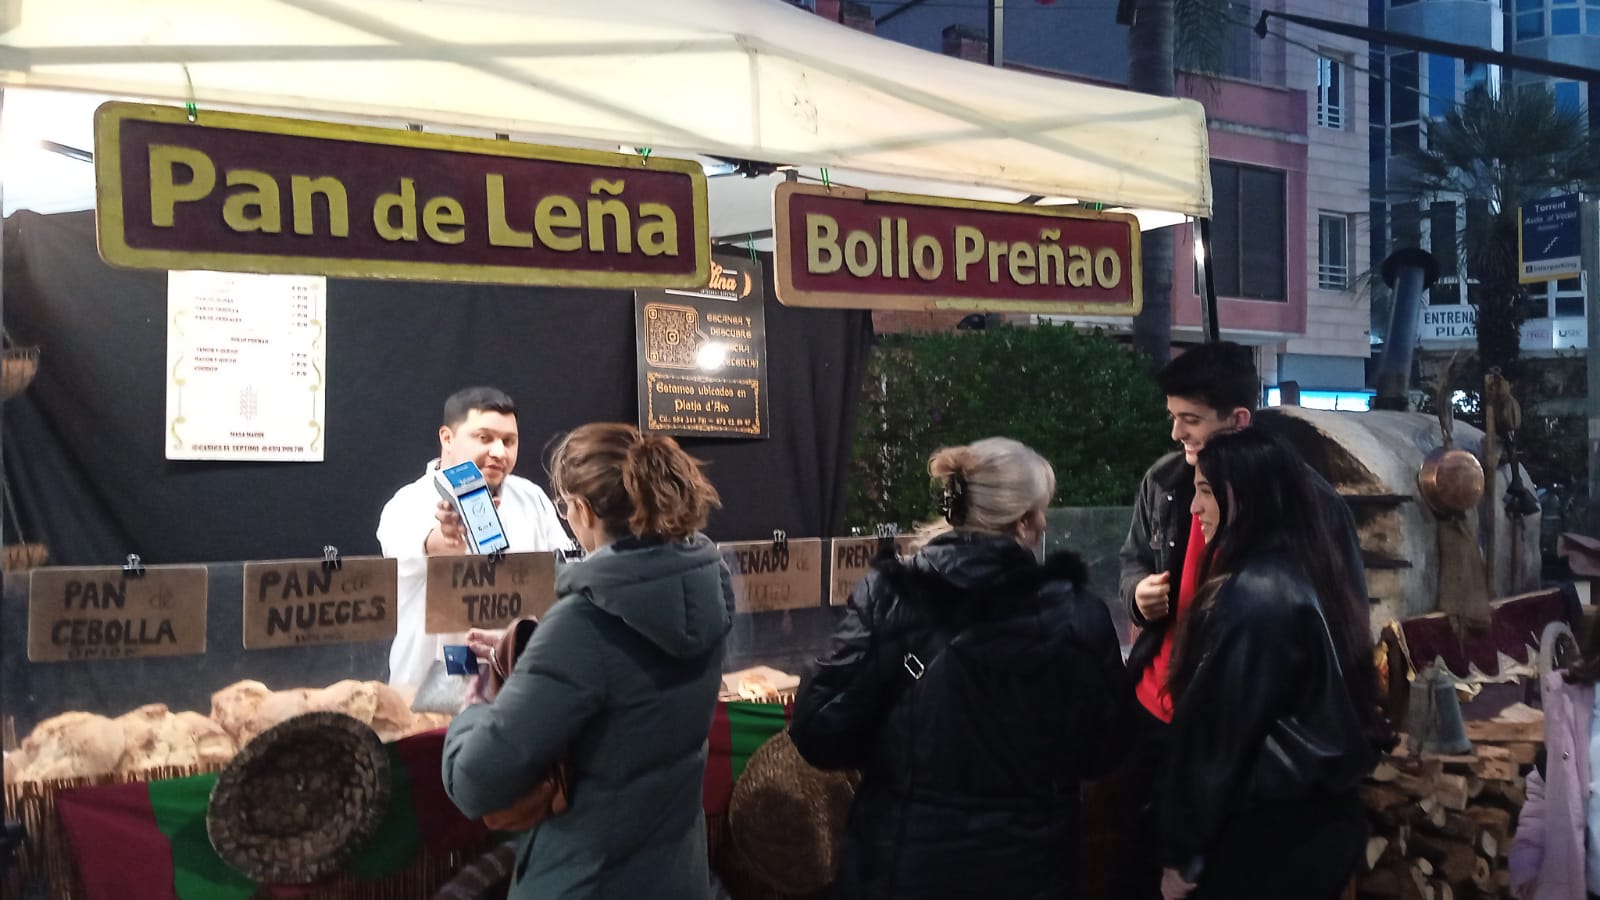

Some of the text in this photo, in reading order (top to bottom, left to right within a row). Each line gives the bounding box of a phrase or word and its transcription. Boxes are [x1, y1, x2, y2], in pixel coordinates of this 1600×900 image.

[148, 143, 679, 257] Pan de Leña
[1535, 201, 1567, 213] Torrent
[806, 213, 1122, 289] Bollo Preñao
[746, 317, 752, 328] Y
[1435, 326, 1477, 337] PILAT
[656, 382, 747, 398] Estamos ubicados en
[674, 399, 730, 413] Platja d'Aro
[64, 580, 127, 609] PAN
[259, 567, 332, 602] PAN
[266, 595, 387, 637] NUECES
[462, 592, 522, 623] TRIGO
[51, 618, 177, 647] CEBOLLA
